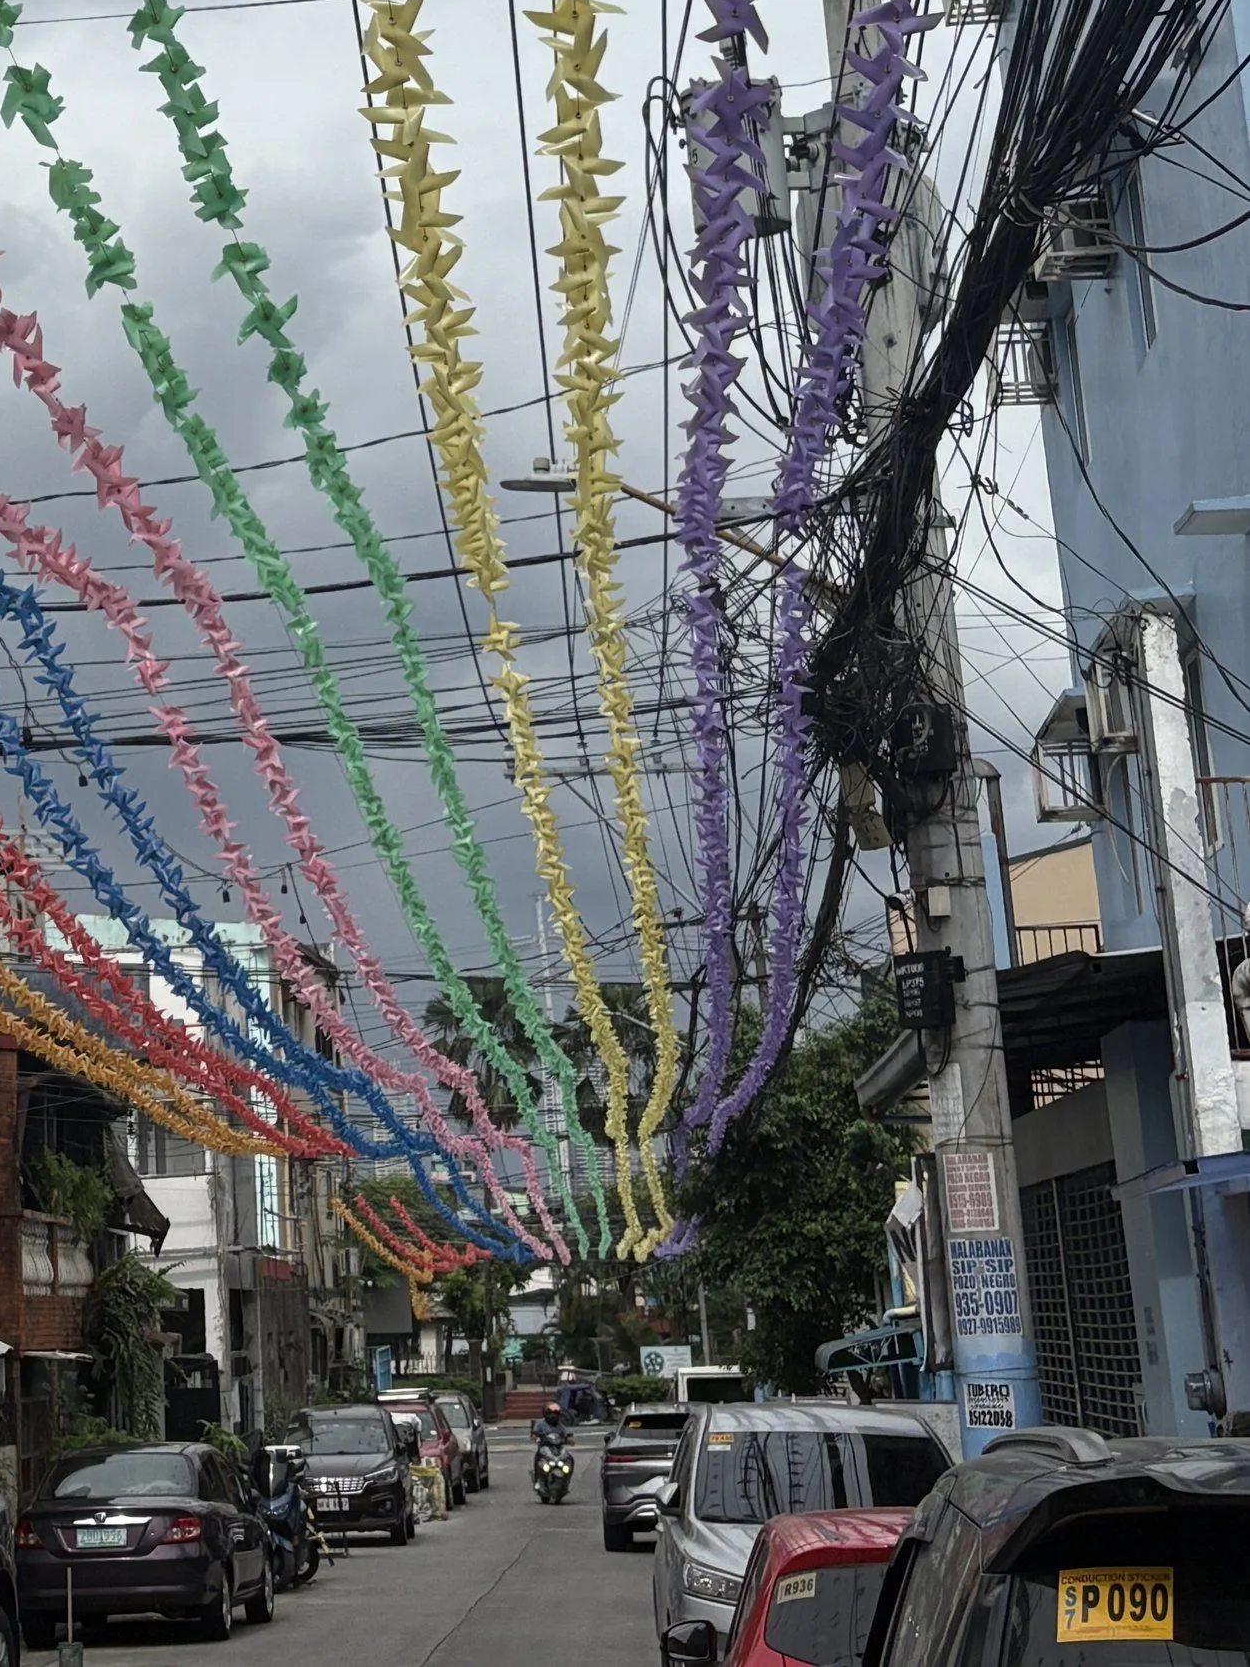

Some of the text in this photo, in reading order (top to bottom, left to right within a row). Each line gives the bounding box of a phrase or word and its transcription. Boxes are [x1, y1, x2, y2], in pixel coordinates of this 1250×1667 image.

[948, 1171, 990, 1184] POZO NEGRO
[950, 1239, 1013, 1258] MALABANAN
[953, 1273, 1016, 1290] POZO NEGRO
[955, 1290, 1018, 1317] 935-0907
[957, 1316, 1021, 1336] 0927-9915989
[968, 1384, 1010, 1397] TUBERO
[1061, 1573, 1171, 1585] CONDUCTION STICKER
